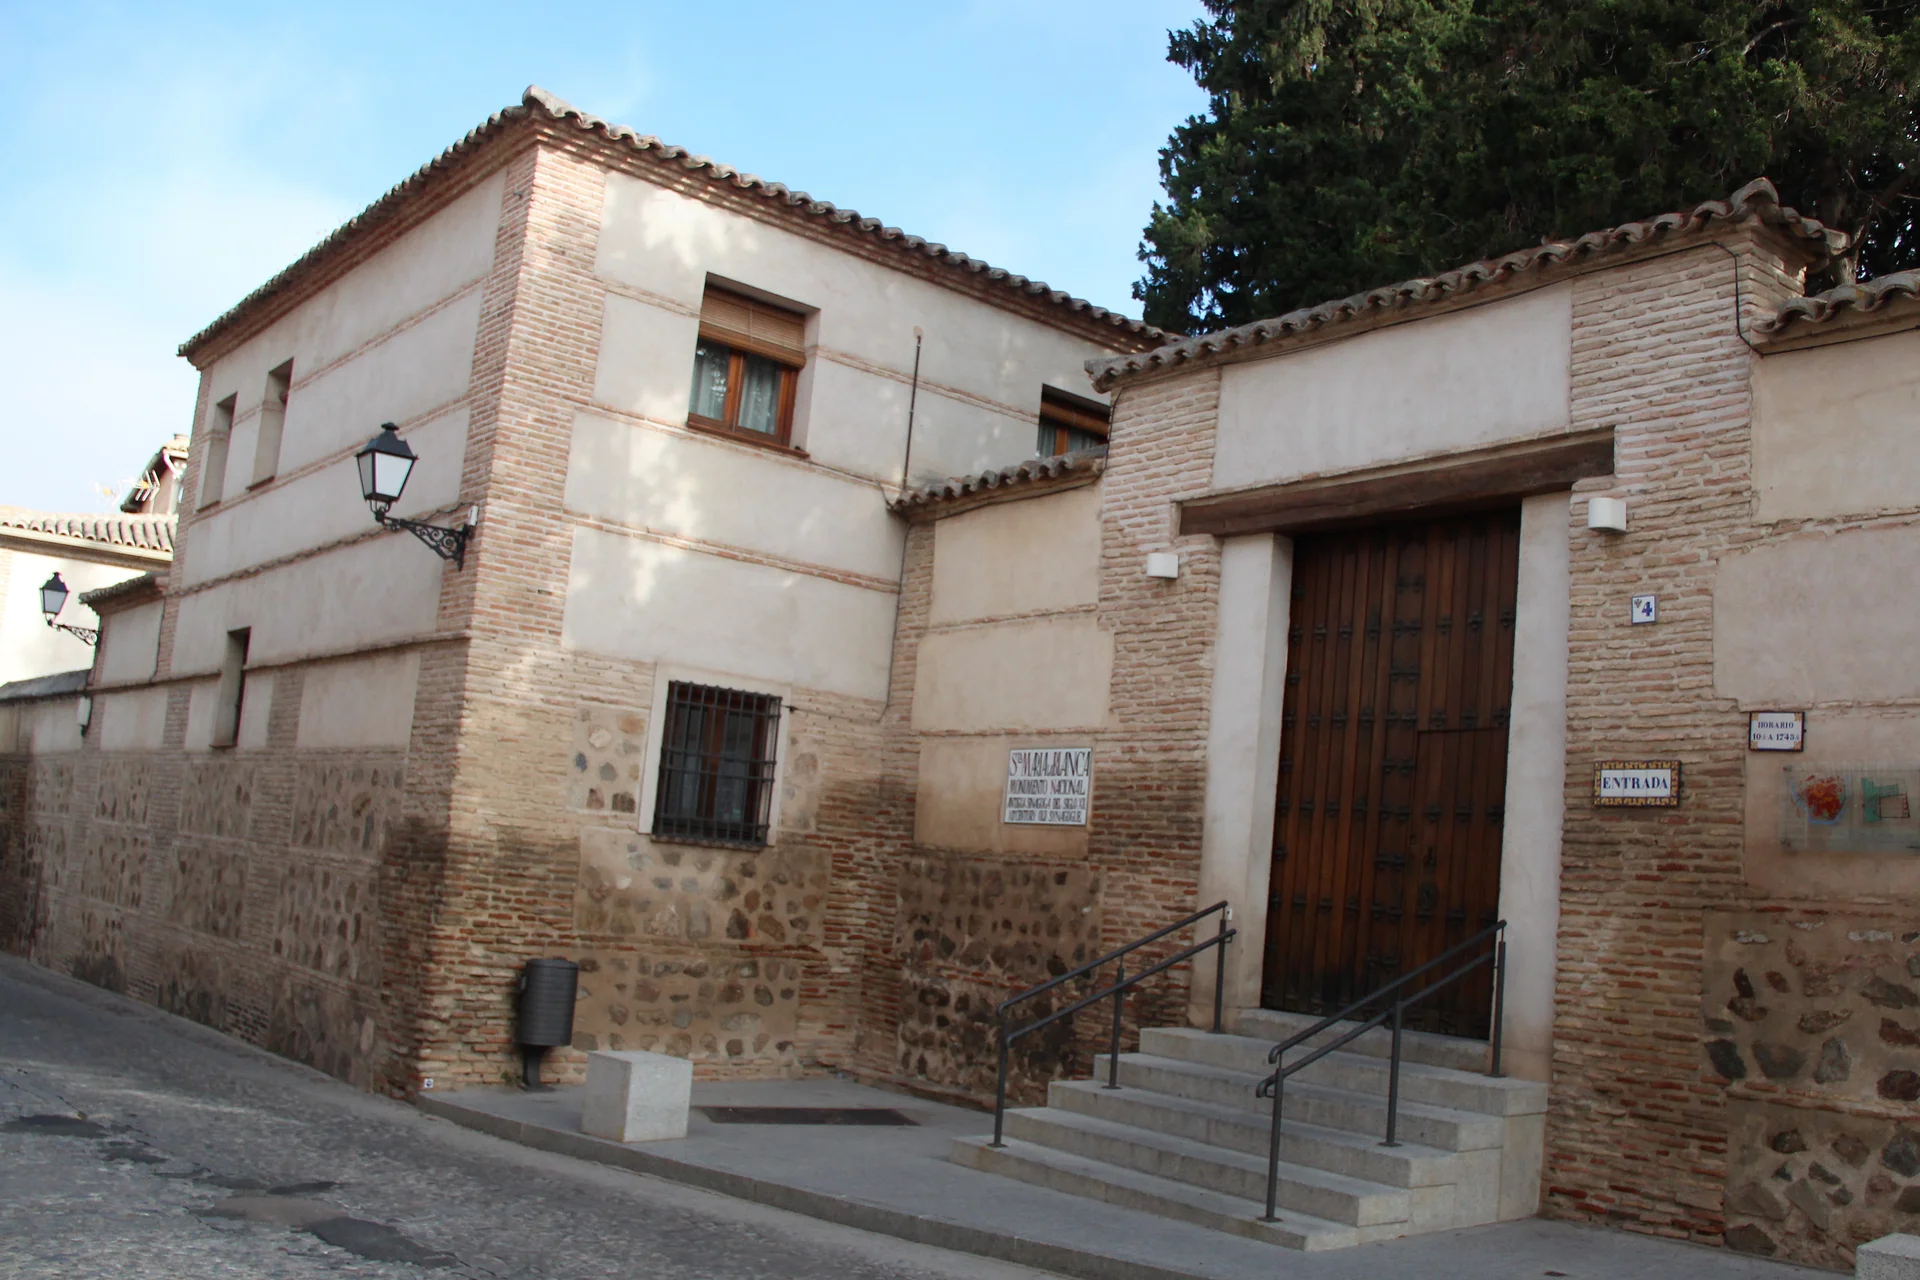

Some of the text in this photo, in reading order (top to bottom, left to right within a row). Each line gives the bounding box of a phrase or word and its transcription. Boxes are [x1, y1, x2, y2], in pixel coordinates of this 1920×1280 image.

[1641, 601, 1653, 617] 4
[1758, 721, 1794, 729] HORARIO
[1053, 751, 1091, 776] BLANCA
[1009, 780, 1085, 795] MONUMENTO NACIONAL
[1603, 777, 1668, 789] ENTRADA
[1048, 811, 1082, 822] SYNAGOGUE
